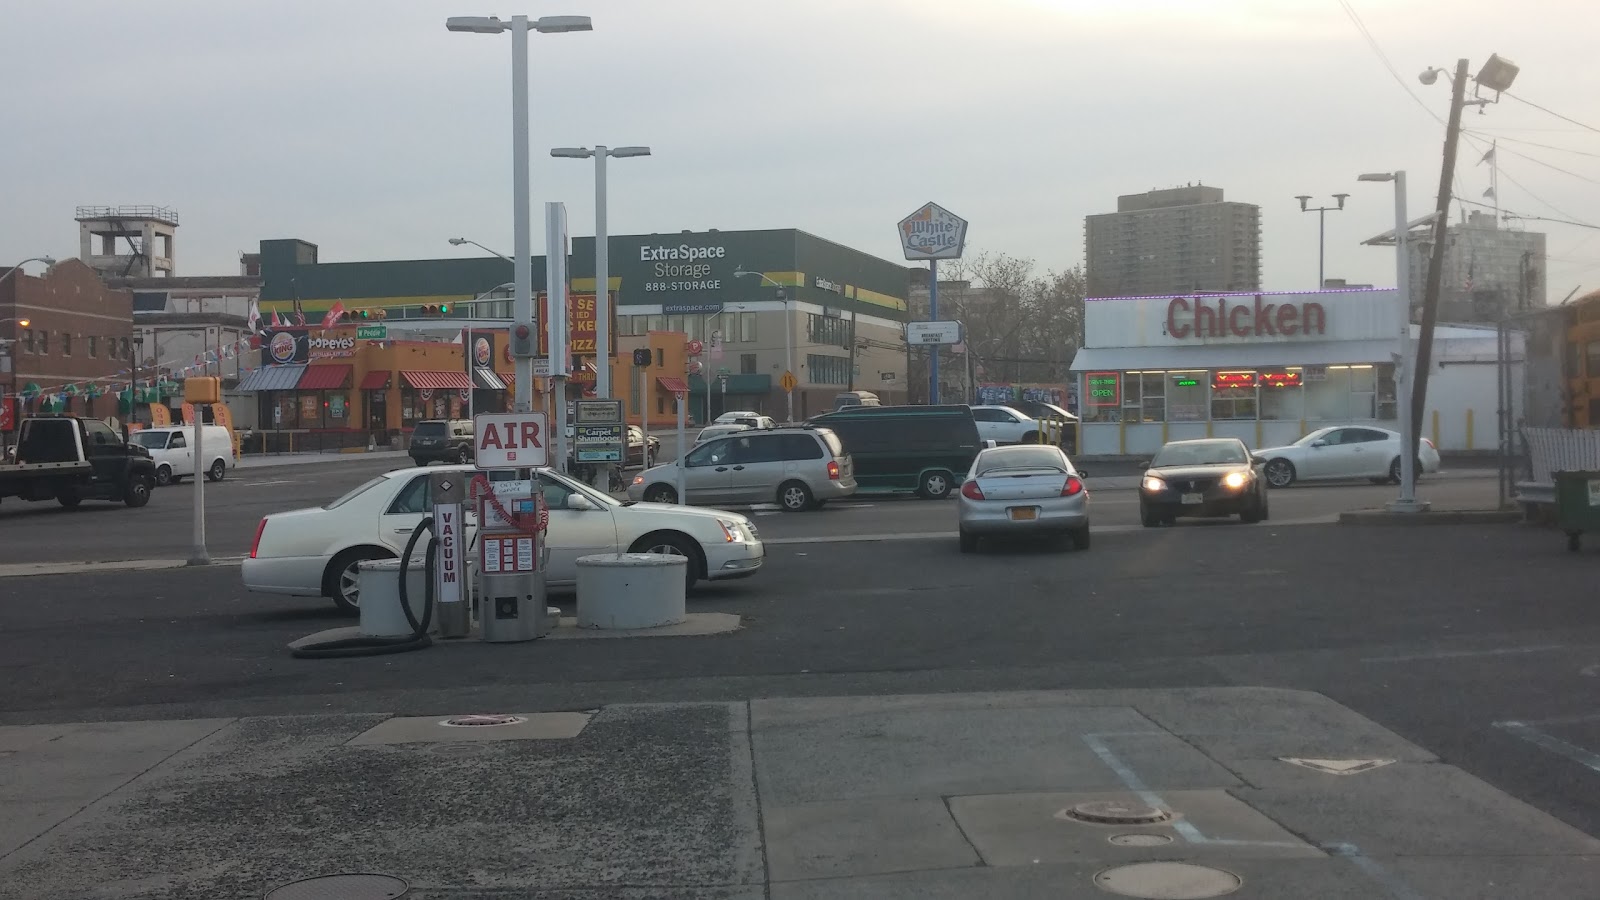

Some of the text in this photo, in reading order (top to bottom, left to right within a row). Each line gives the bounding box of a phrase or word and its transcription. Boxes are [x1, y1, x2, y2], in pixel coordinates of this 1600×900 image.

[911, 221, 953, 235] White
[907, 234, 956, 247] Castle
[654, 262, 711, 279] Storage
[645, 280, 721, 292] 888-STORAGE
[665, 304, 720, 312] extraspace.com
[1167, 293, 1326, 339] Chicken
[274, 343, 293, 356] KING
[1091, 389, 1114, 397] OPEN
[480, 422, 543, 450] AIR
[577, 435, 620, 443] Shampooer
[585, 429, 612, 441] Carpet
[442, 513, 455, 582] VACUUM
